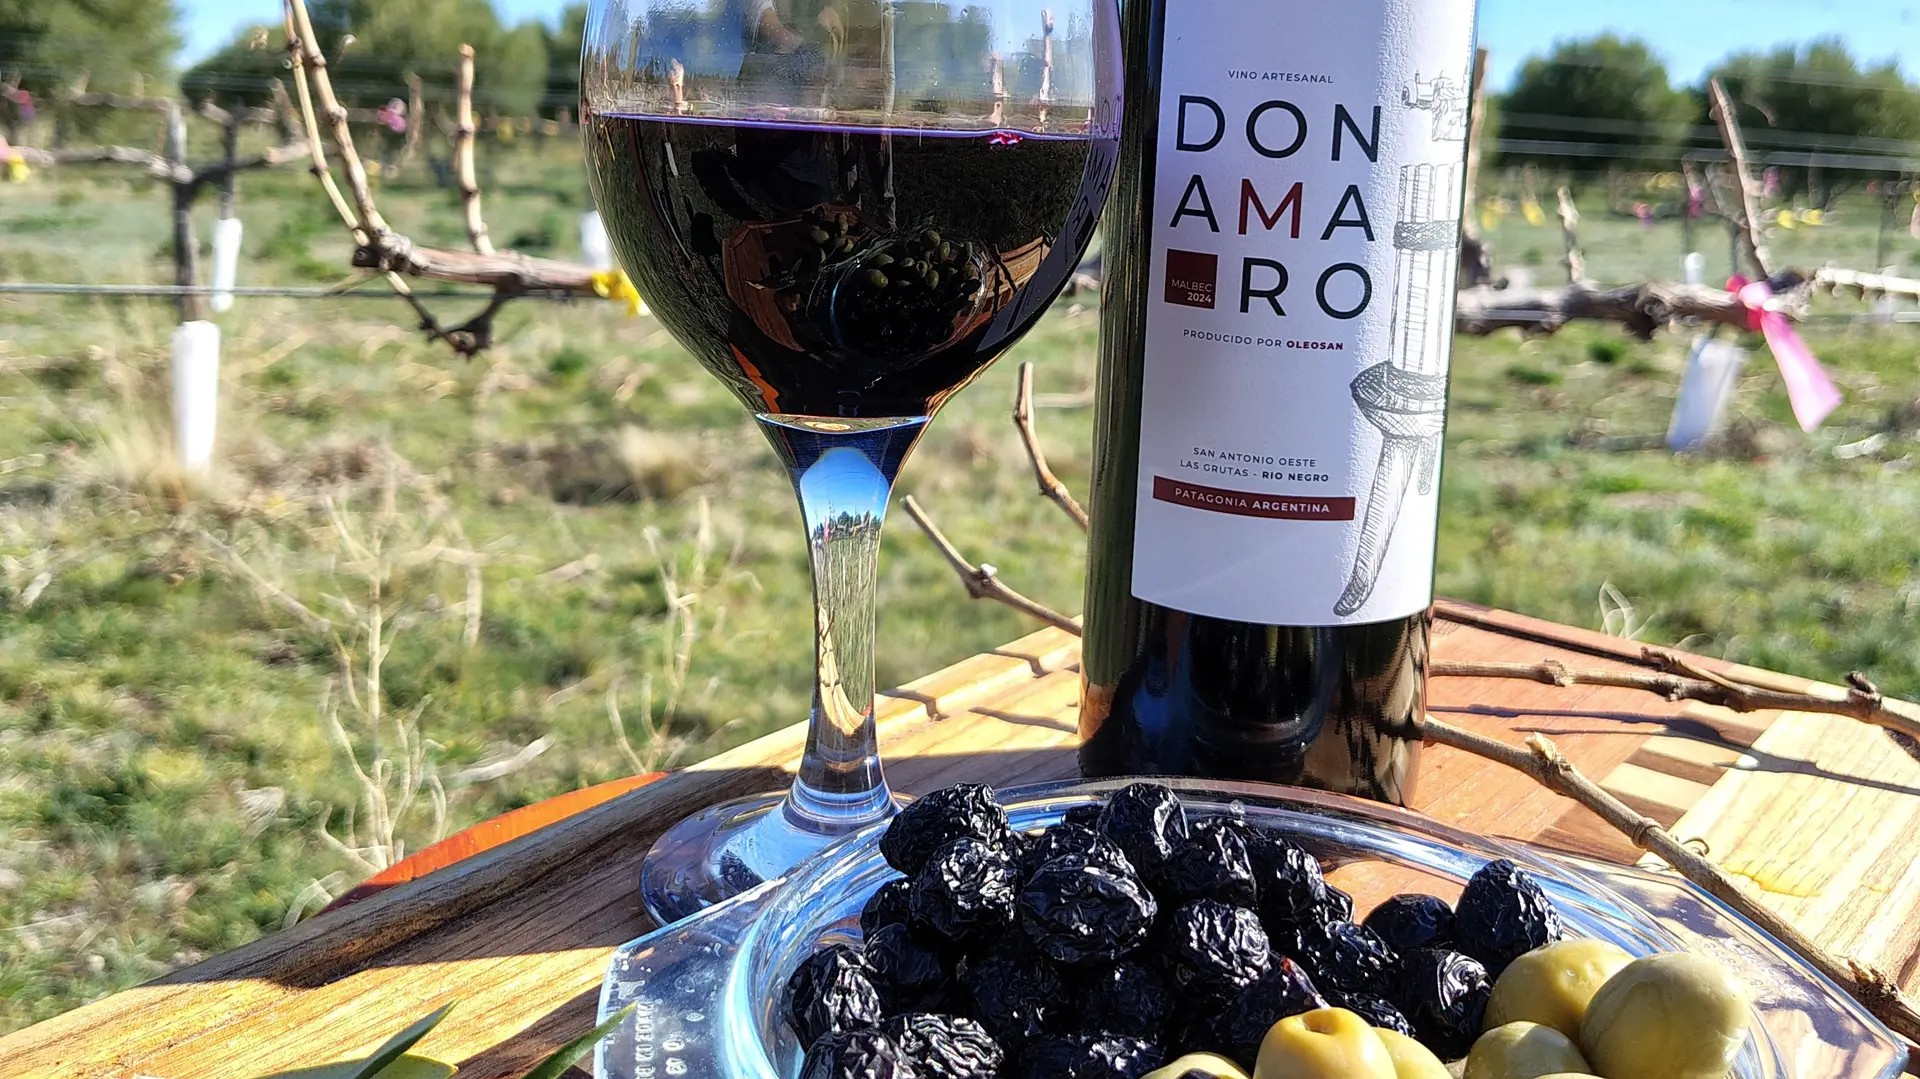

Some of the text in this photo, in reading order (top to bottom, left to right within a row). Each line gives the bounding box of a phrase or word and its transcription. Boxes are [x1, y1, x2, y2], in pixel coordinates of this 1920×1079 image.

[1228, 70, 1334, 84] VINO ARTESANAL
[1176, 95, 1381, 162] DON
[1169, 174, 1375, 241] AMA
[1171, 279, 1213, 293] MALBEC
[1239, 256, 1372, 319] RO
[1187, 292, 1212, 304] 2024
[1183, 329, 1344, 351] PRODUCIDO POR OLEOSAN
[1193, 447, 1316, 468] SAN ANTONIO OESTE
[1180, 459, 1200, 470] LAS
[1203, 463, 1249, 477] GRUTAS
[1262, 471, 1283, 480] RIO
[1288, 473, 1329, 482] NEGRO
[1175, 487, 1331, 513] PATAGONIA ARGENTINA
